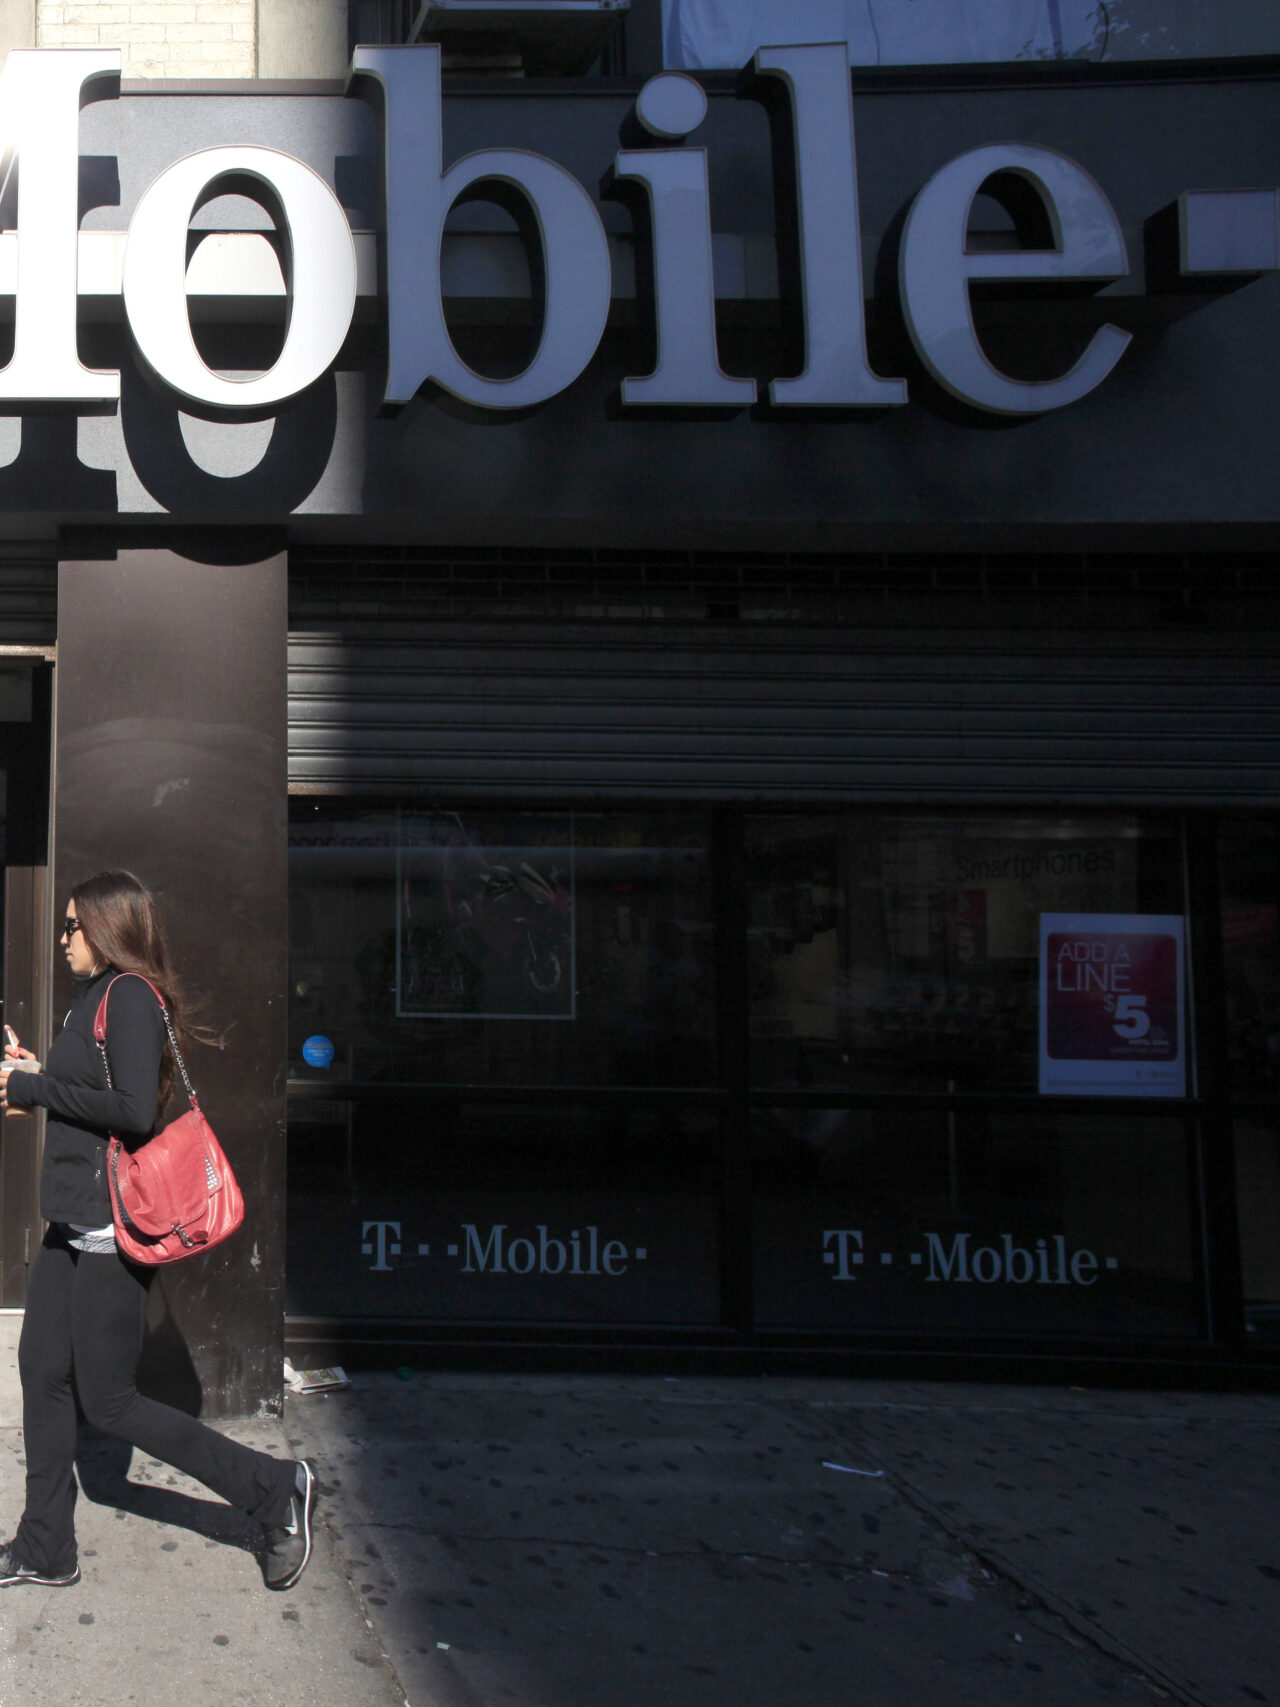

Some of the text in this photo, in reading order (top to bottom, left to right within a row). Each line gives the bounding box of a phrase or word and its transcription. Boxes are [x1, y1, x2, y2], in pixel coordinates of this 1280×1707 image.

[956, 848, 1115, 882] Smartphones
[1057, 942, 1131, 962] ADD A
[1056, 963, 1132, 993] LINE
